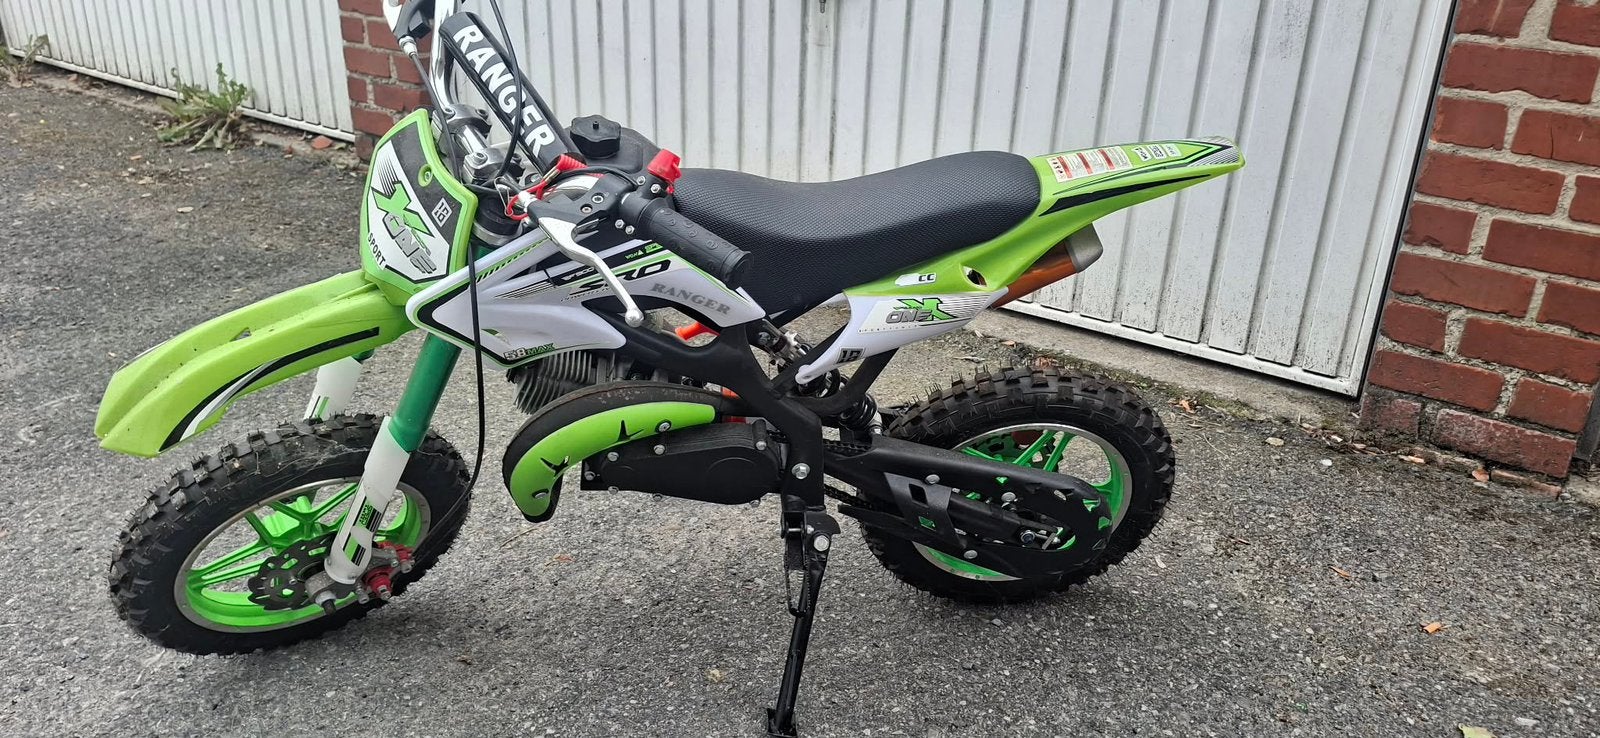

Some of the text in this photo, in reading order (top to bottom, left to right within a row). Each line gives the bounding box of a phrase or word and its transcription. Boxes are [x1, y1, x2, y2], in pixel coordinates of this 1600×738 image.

[453, 25, 556, 158] RANGER
[367, 232, 386, 266] SPORT
[918, 273, 935, 282] CC
[650, 283, 730, 314] RANGER
